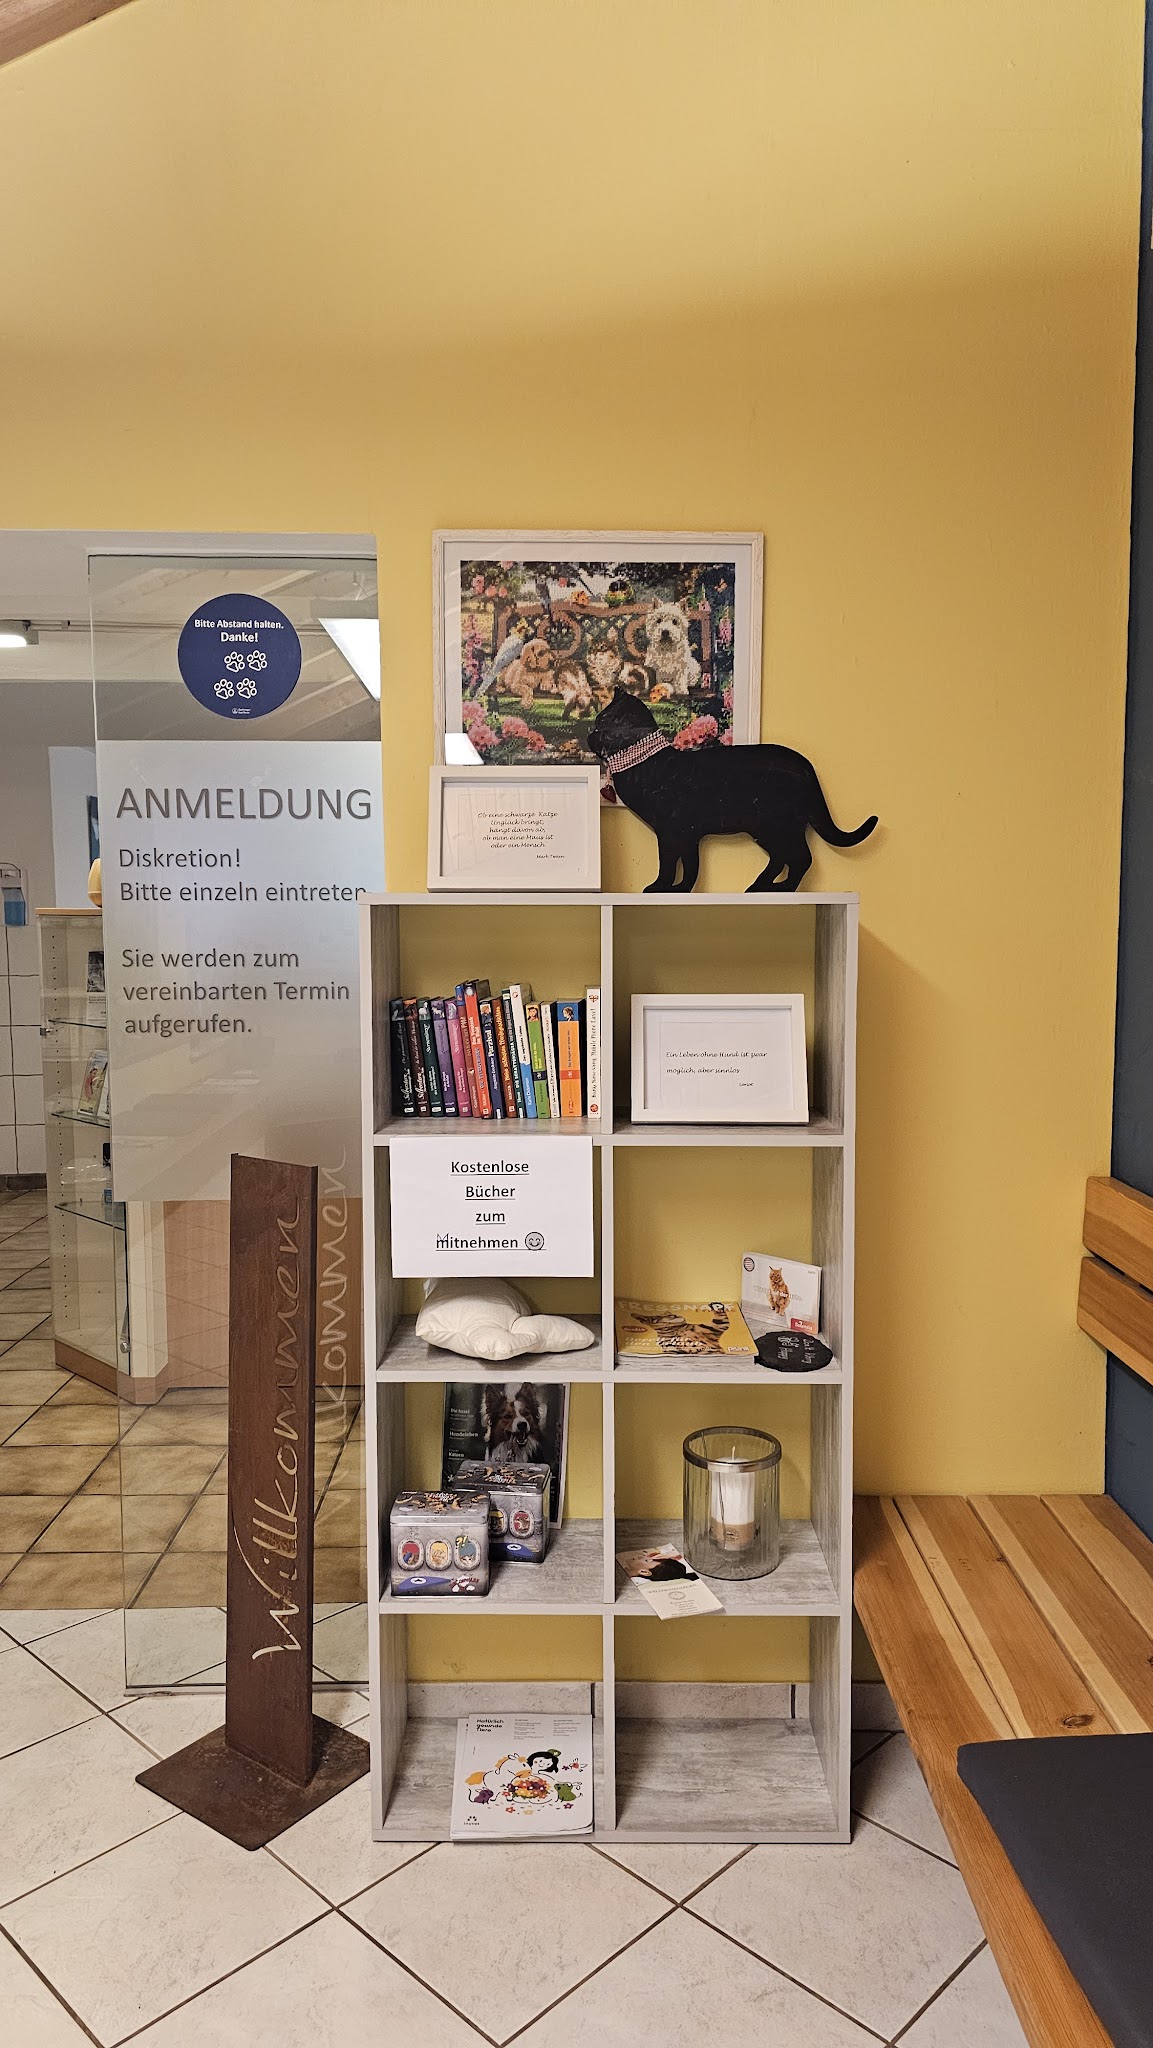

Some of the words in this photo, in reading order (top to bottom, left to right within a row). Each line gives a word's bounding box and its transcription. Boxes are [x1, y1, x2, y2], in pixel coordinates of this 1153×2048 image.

[194, 619, 215, 628] Bitte
[217, 619, 252, 629] Abstand
[254, 620, 284, 630] halten.
[220, 632, 258, 642] Danke!
[116, 788, 372, 820] ANMELDUNG
[119, 848, 241, 868] Diskretion!
[120, 882, 172, 902] Bitte
[179, 882, 257, 902] einzeln
[122, 949, 154, 968] Sie
[161, 948, 245, 968] werden
[253, 952, 300, 968] zum
[123, 981, 267, 1001] vereinbarten
[273, 981, 350, 1001] Termin
[124, 1013, 252, 1038] aufgerufen.
[485, 1030, 494, 1057] Parzival
[451, 1160, 529, 1173] Kostenlose
[466, 1185, 516, 1198] Bücher
[475, 1212, 505, 1222] zum
[436, 1233, 518, 1249] Mitnehmen
[618, 1301, 735, 1312] FRESSNAPF
[233, 1198, 302, 1660] Willkommen
